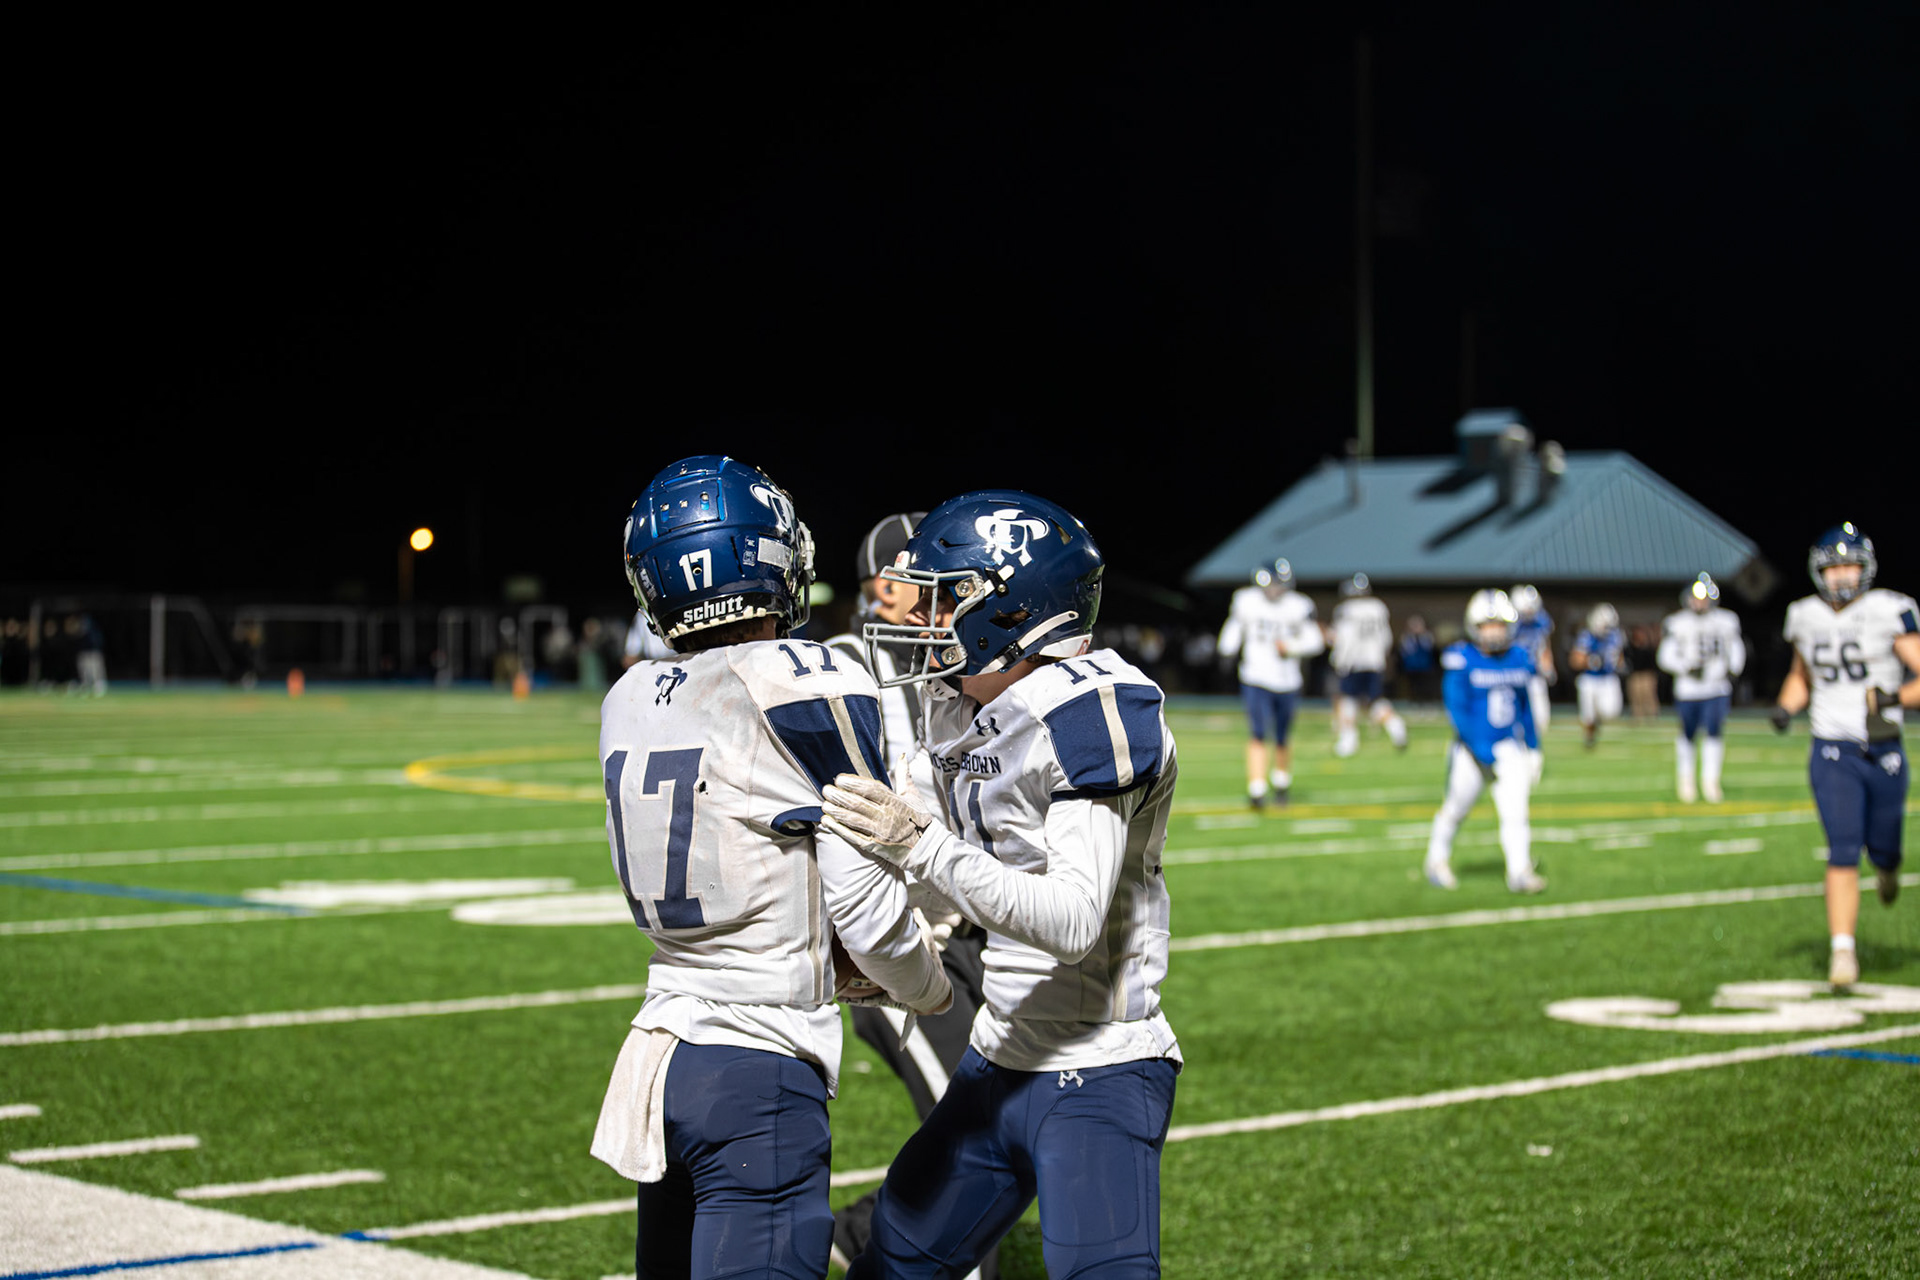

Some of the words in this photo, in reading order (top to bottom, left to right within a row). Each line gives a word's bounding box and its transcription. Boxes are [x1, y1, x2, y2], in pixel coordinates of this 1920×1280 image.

[679, 548, 713, 592] 17
[683, 595, 744, 624] schutt
[778, 642, 841, 679] 17
[1054, 659, 1113, 685] 11
[1812, 641, 1869, 683] 56
[604, 746, 708, 930] 17
